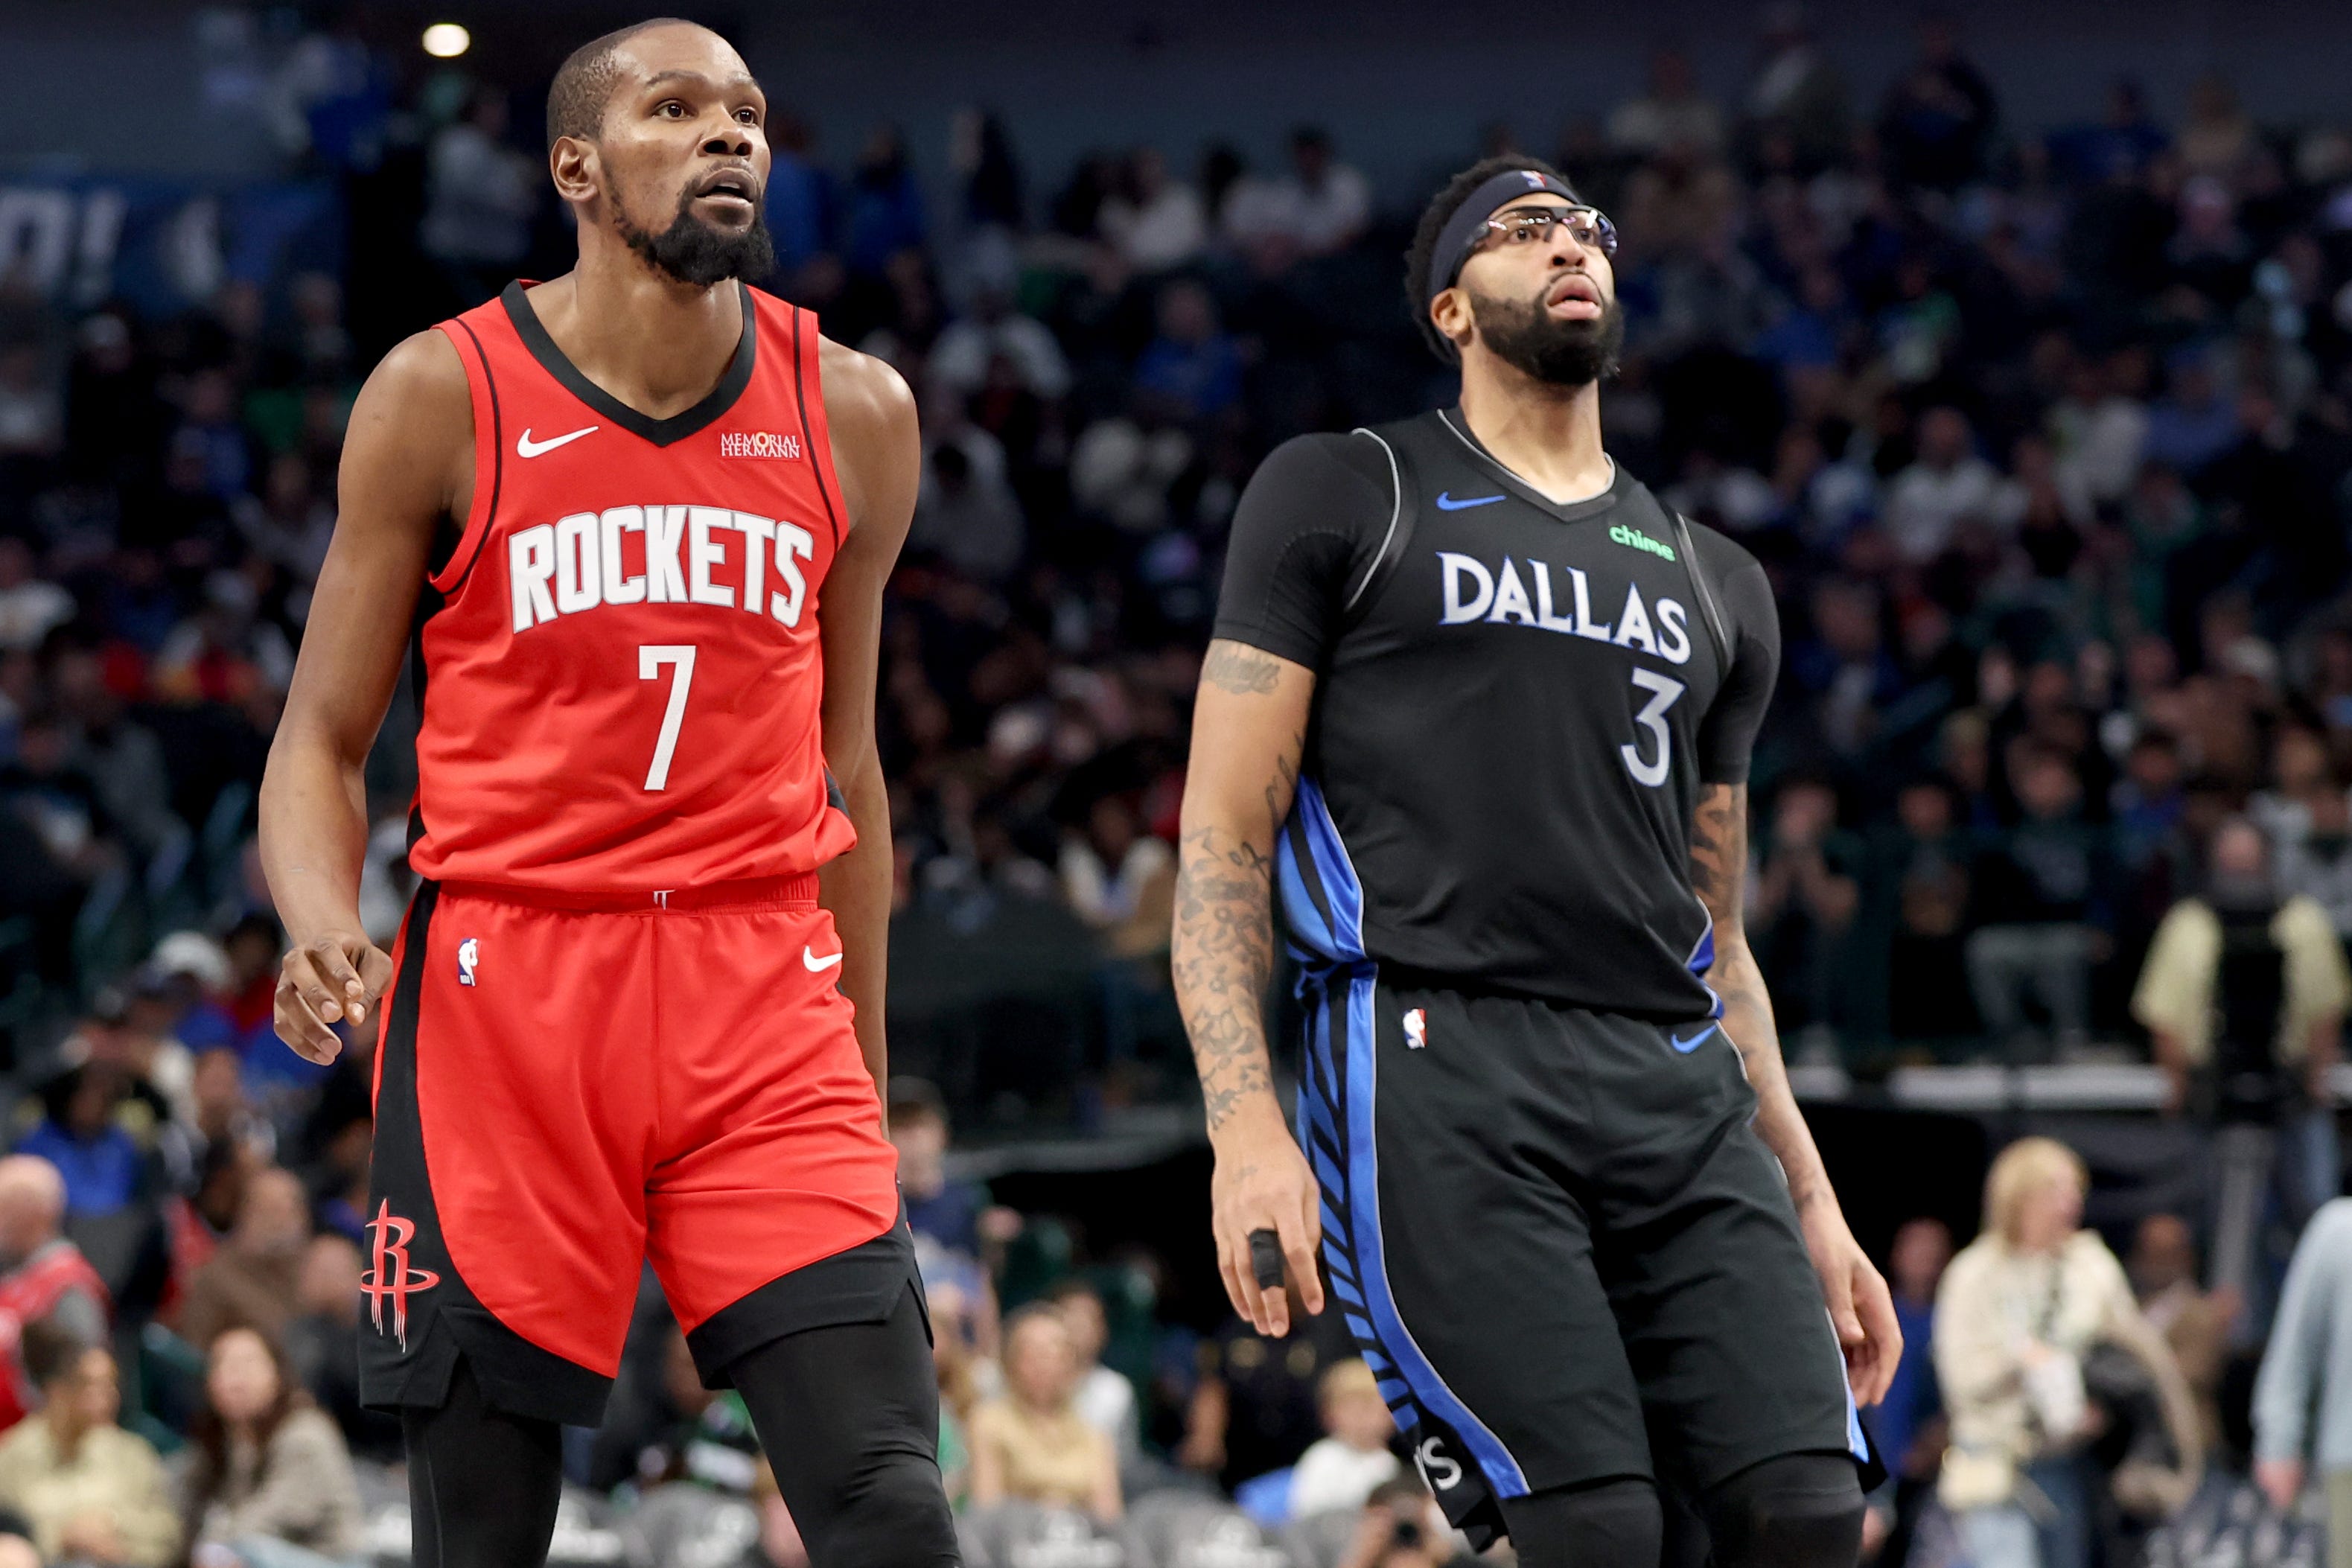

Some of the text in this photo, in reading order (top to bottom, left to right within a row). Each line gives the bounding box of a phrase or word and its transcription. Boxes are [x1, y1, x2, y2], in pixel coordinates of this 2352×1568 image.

[721, 432, 800, 447] MEMORIAL
[721, 444, 800, 458] HERMANN
[509, 505, 814, 634] ROCKETS
[1609, 524, 1676, 561] chime
[1435, 552, 1692, 665] DALLAS
[639, 645, 697, 791] 7
[1620, 666, 1688, 788] 3
